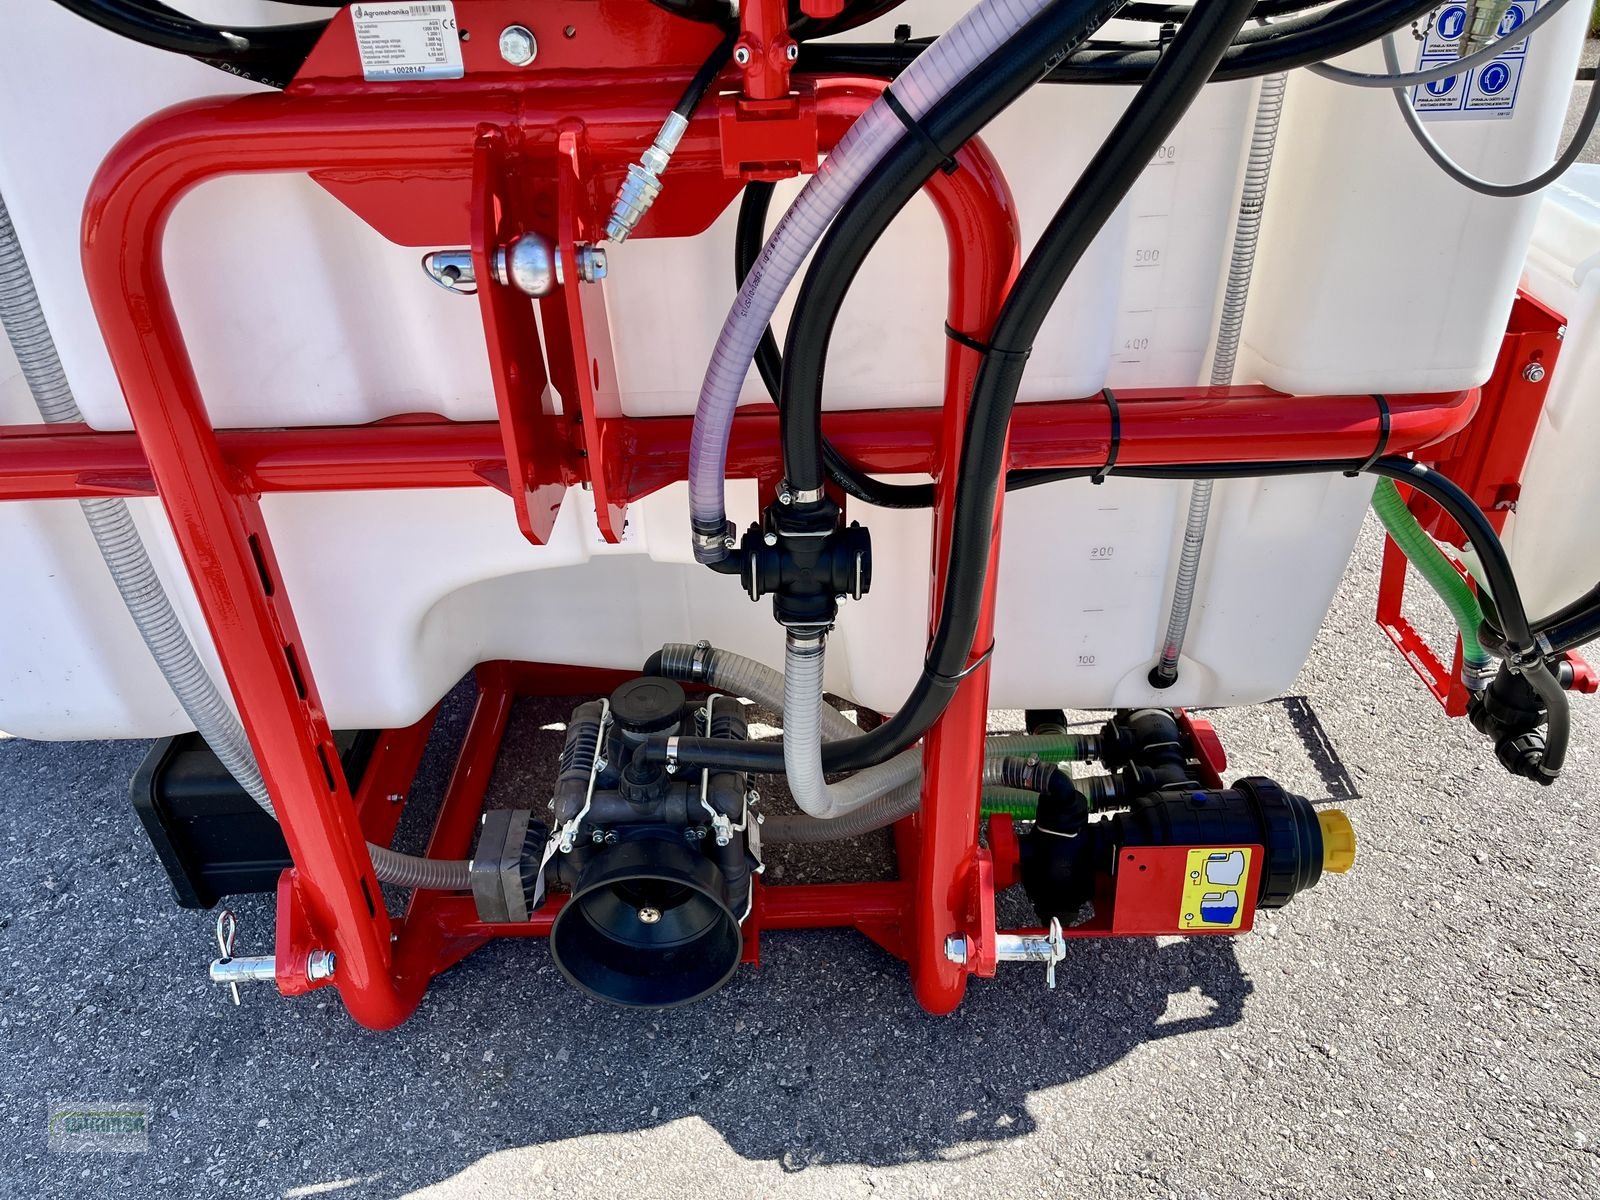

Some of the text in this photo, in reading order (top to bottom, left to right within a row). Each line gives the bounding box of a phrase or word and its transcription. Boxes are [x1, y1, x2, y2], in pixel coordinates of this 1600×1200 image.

[363, 7, 410, 19] Agromehanika
[1085, 14, 1101, 35] IN
[1044, 35, 1080, 73] ITALY
[220, 62, 241, 75] DN
[393, 66, 426, 74] 10028147
[1135, 249, 1160, 262] 500
[1124, 337, 1149, 350] 400
[1090, 545, 1115, 558] 200
[1076, 654, 1096, 665] 100
